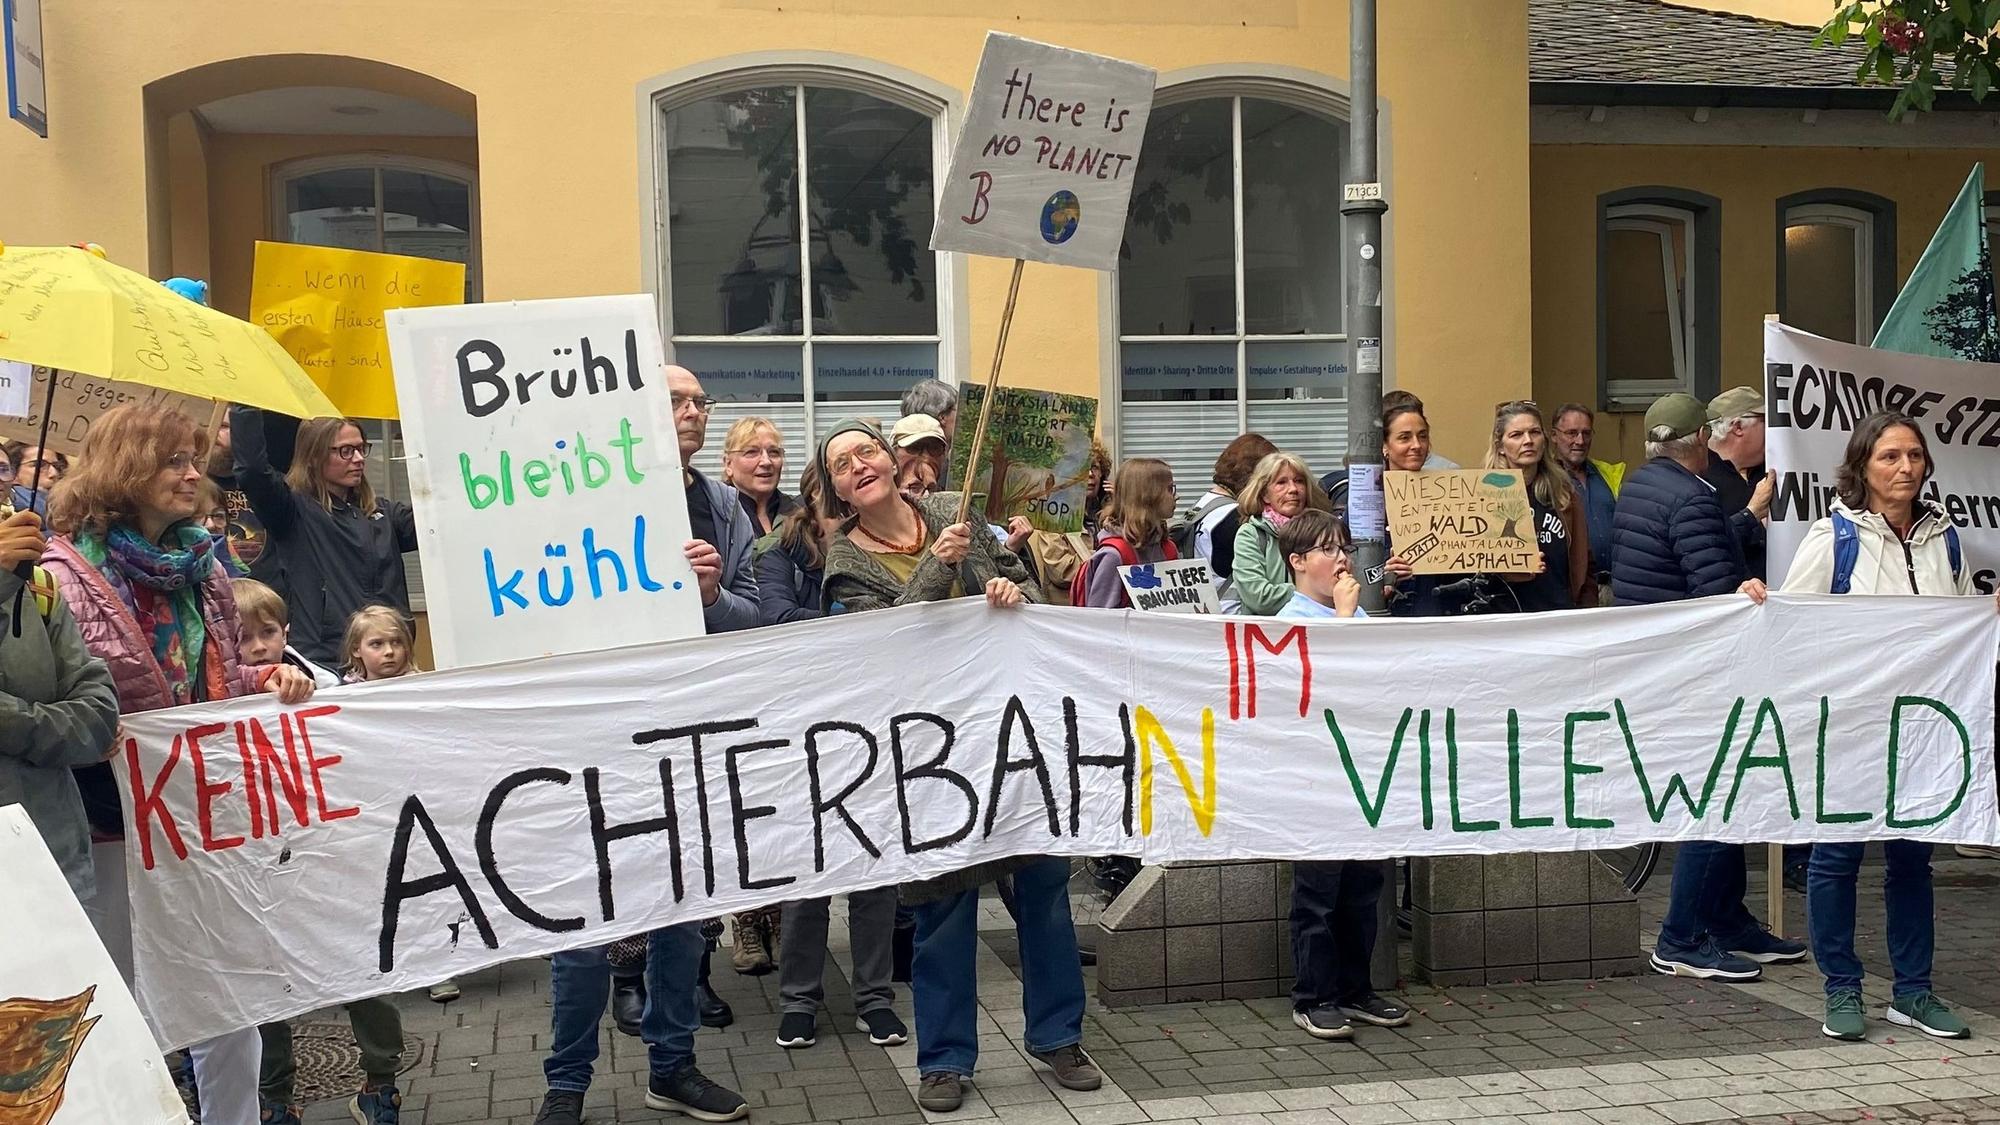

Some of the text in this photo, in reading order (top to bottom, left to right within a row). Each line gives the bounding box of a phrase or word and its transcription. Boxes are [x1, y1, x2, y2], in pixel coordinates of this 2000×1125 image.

[1000, 68, 1130, 133] there is
[982, 134, 1132, 180] NO PLANET
[961, 171, 993, 225] B
[385, 272, 422, 297] die
[263, 301, 384, 330] ersten Häuse
[349, 351, 382, 369] sind
[818, 366, 934, 378] Einzelhandel 4.0 Förderung
[1163, 365, 1190, 377] Sharing
[1250, 366, 1277, 376] Impulse
[1284, 365, 1322, 376] Gestaltung
[456, 328, 645, 418] Brühl
[754, 369, 795, 380] Marketing
[1007, 432, 1053, 449] NATUR
[459, 417, 645, 510] bleibt
[1026, 498, 1069, 517] STOP
[1395, 515, 1488, 537] UND WALD
[1406, 536, 1526, 561] STATT PHANTALAND
[483, 514, 683, 617] kühl.
[1427, 552, 1534, 570] UND ASPHALT
[1165, 566, 1209, 587] TIERE
[1136, 587, 1200, 610] BRAUCHEN
[1225, 622, 1312, 719] IM
[126, 694, 1971, 973] KEINE ACHTERBAHN VILLEWALD
